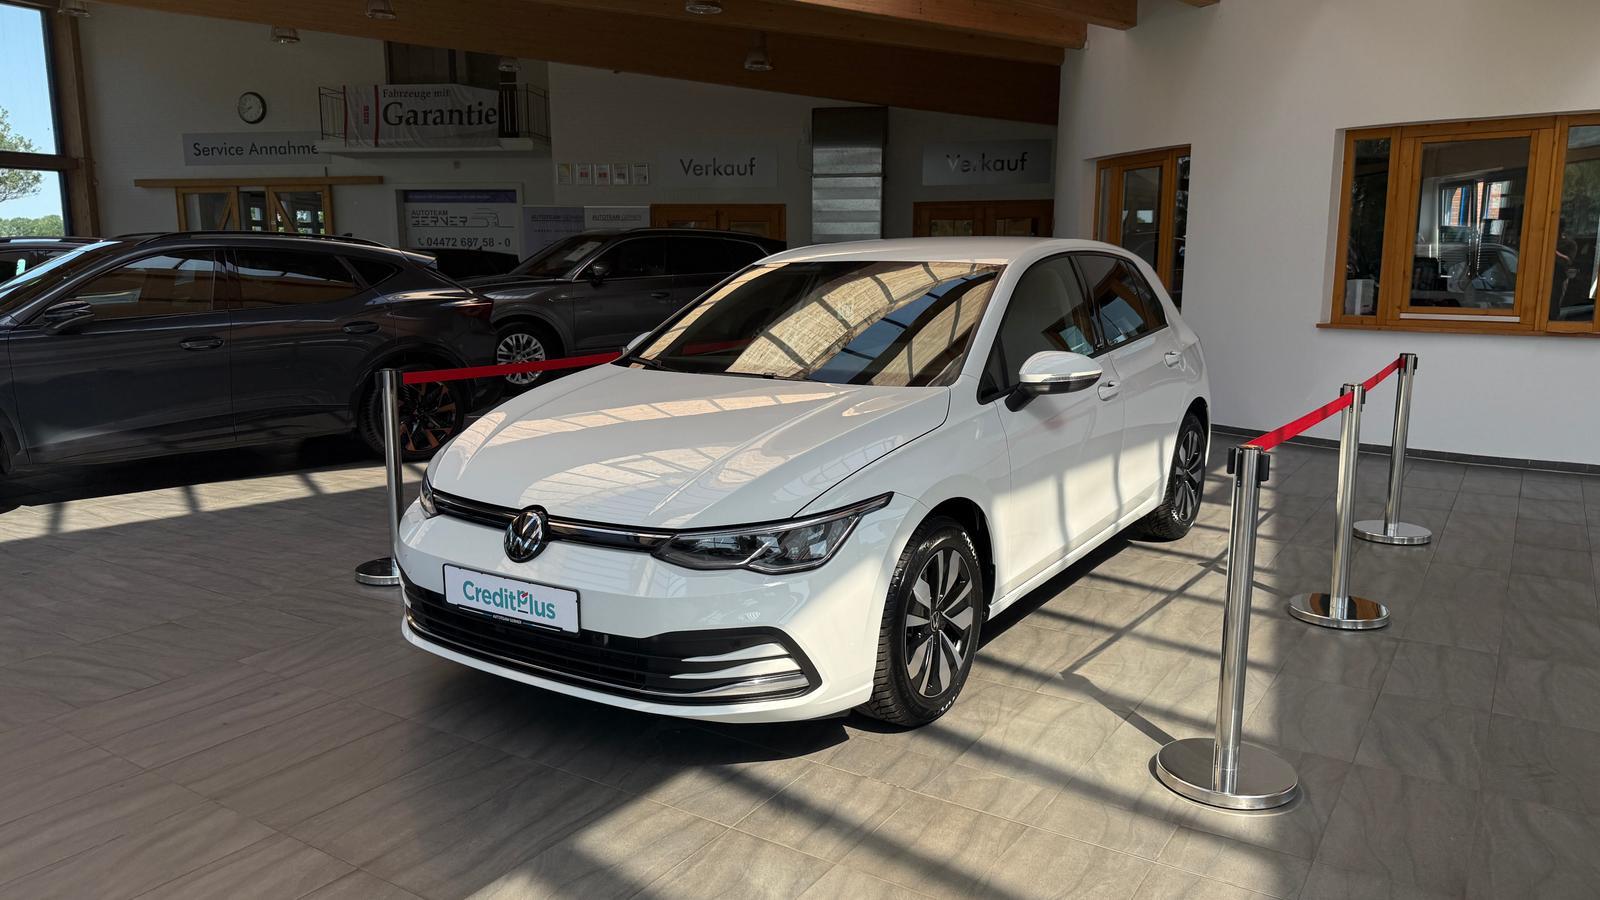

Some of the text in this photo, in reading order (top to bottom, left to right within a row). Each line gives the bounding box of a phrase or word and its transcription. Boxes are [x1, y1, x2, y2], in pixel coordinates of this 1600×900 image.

[382, 88, 431, 100] Fahrzeuge
[382, 101, 497, 126] Garantie
[193, 140, 319, 157] Service Annahme
[679, 157, 756, 177] Verkauf
[426, 237, 457, 247] 04472
[460, 237, 479, 247] 687
[482, 237, 495, 247] 58
[504, 237, 511, 247] 0
[462, 580, 556, 619] CreditPlus
